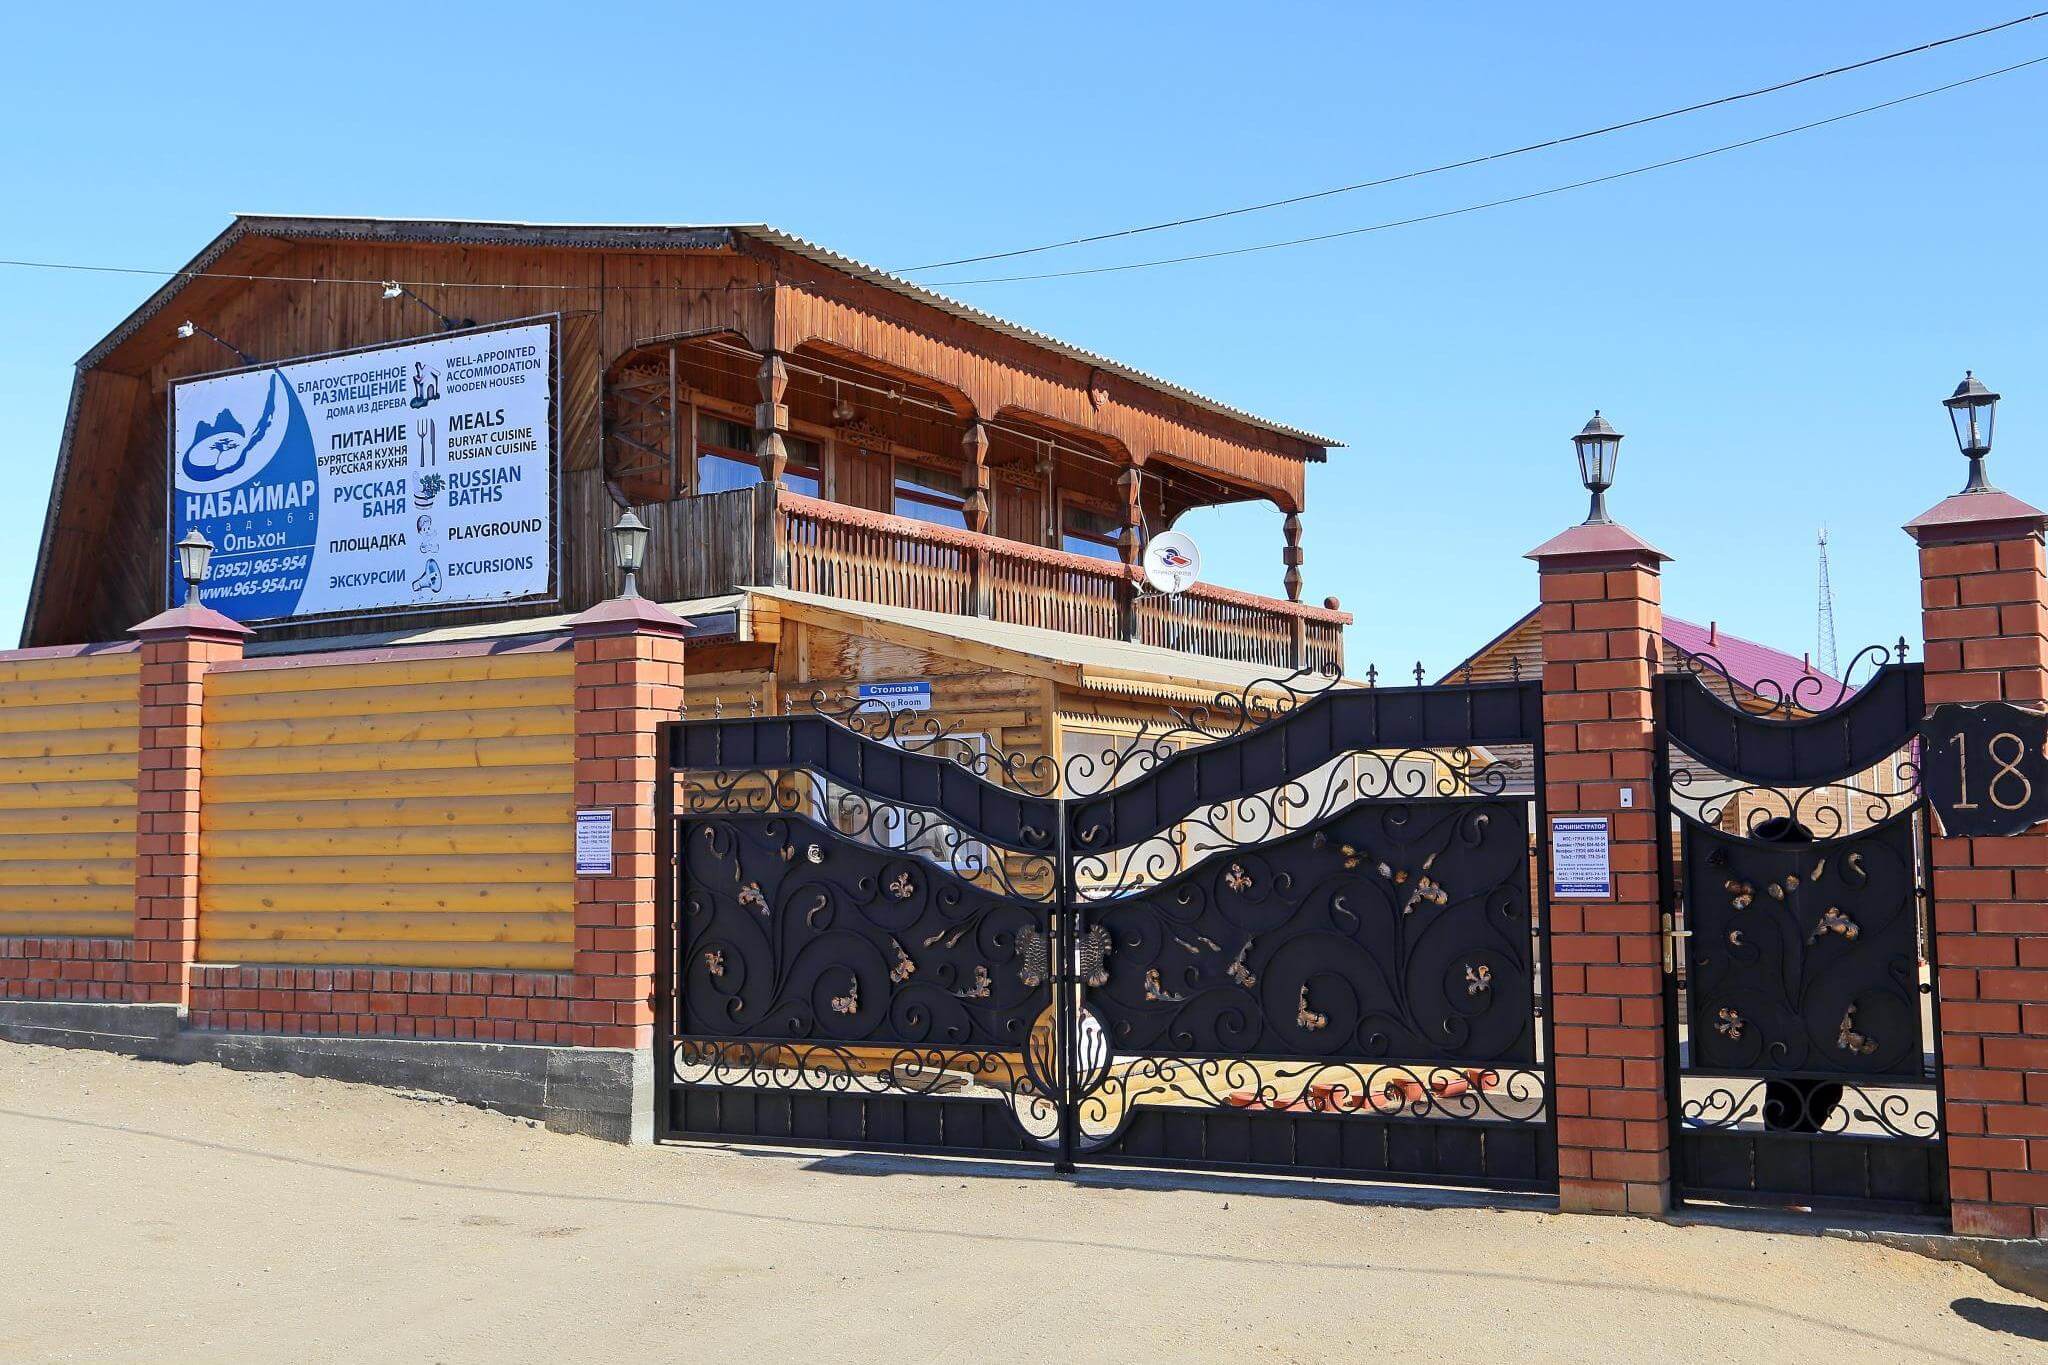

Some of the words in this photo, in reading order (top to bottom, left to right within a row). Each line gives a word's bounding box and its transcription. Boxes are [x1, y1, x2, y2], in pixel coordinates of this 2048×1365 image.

[446, 345, 536, 369] WELL-APPOINTED
[297, 365, 407, 394] БЛАГОУСТРОЕННОЕ
[446, 358, 541, 382] ACCOMMODATION
[313, 378, 407, 406] РАЗМЕЩЕНИЕ
[446, 380, 487, 395] WOODEN
[489, 374, 526, 388] HOUSES
[326, 406, 355, 420] ДОМА
[356, 402, 369, 414] ИЗ
[370, 397, 407, 414] ДЕРЕВА
[448, 408, 505, 432] MEALS
[331, 424, 407, 450] ПИТАНИЕ
[448, 433, 488, 448] BURYAT
[490, 427, 532, 443] CUISINE
[317, 449, 373, 467] БУРЯТСКАЯ
[374, 444, 408, 460] КУХНЯ
[448, 446, 493, 461] RUSSIAN
[495, 440, 537, 455] CUISINE
[329, 460, 373, 476] РУССКАЯ
[374, 456, 408, 470] КУХНЯ
[448, 465, 521, 489] RUSSIAN
[186, 480, 315, 521] НАБАЙМАР
[333, 478, 406, 503] РУССКАЯ
[448, 485, 503, 507] BATHS
[362, 498, 406, 519] БАНЯ
[448, 518, 542, 541] PLAYGROUND
[223, 532, 286, 552] Ольхон
[329, 532, 407, 554] ПЛОЩАДКА
[213, 560, 253, 581] (3952)
[253, 554, 308, 575] 965-954
[448, 556, 533, 577] EXCURSIONS
[199, 577, 303, 600] www.965-954.ru
[329, 568, 406, 589] ЭКСКУРСИИ
[870, 685, 919, 694] Столовая
[897, 698, 922, 706] Room
[1949, 732, 2032, 810] 18
